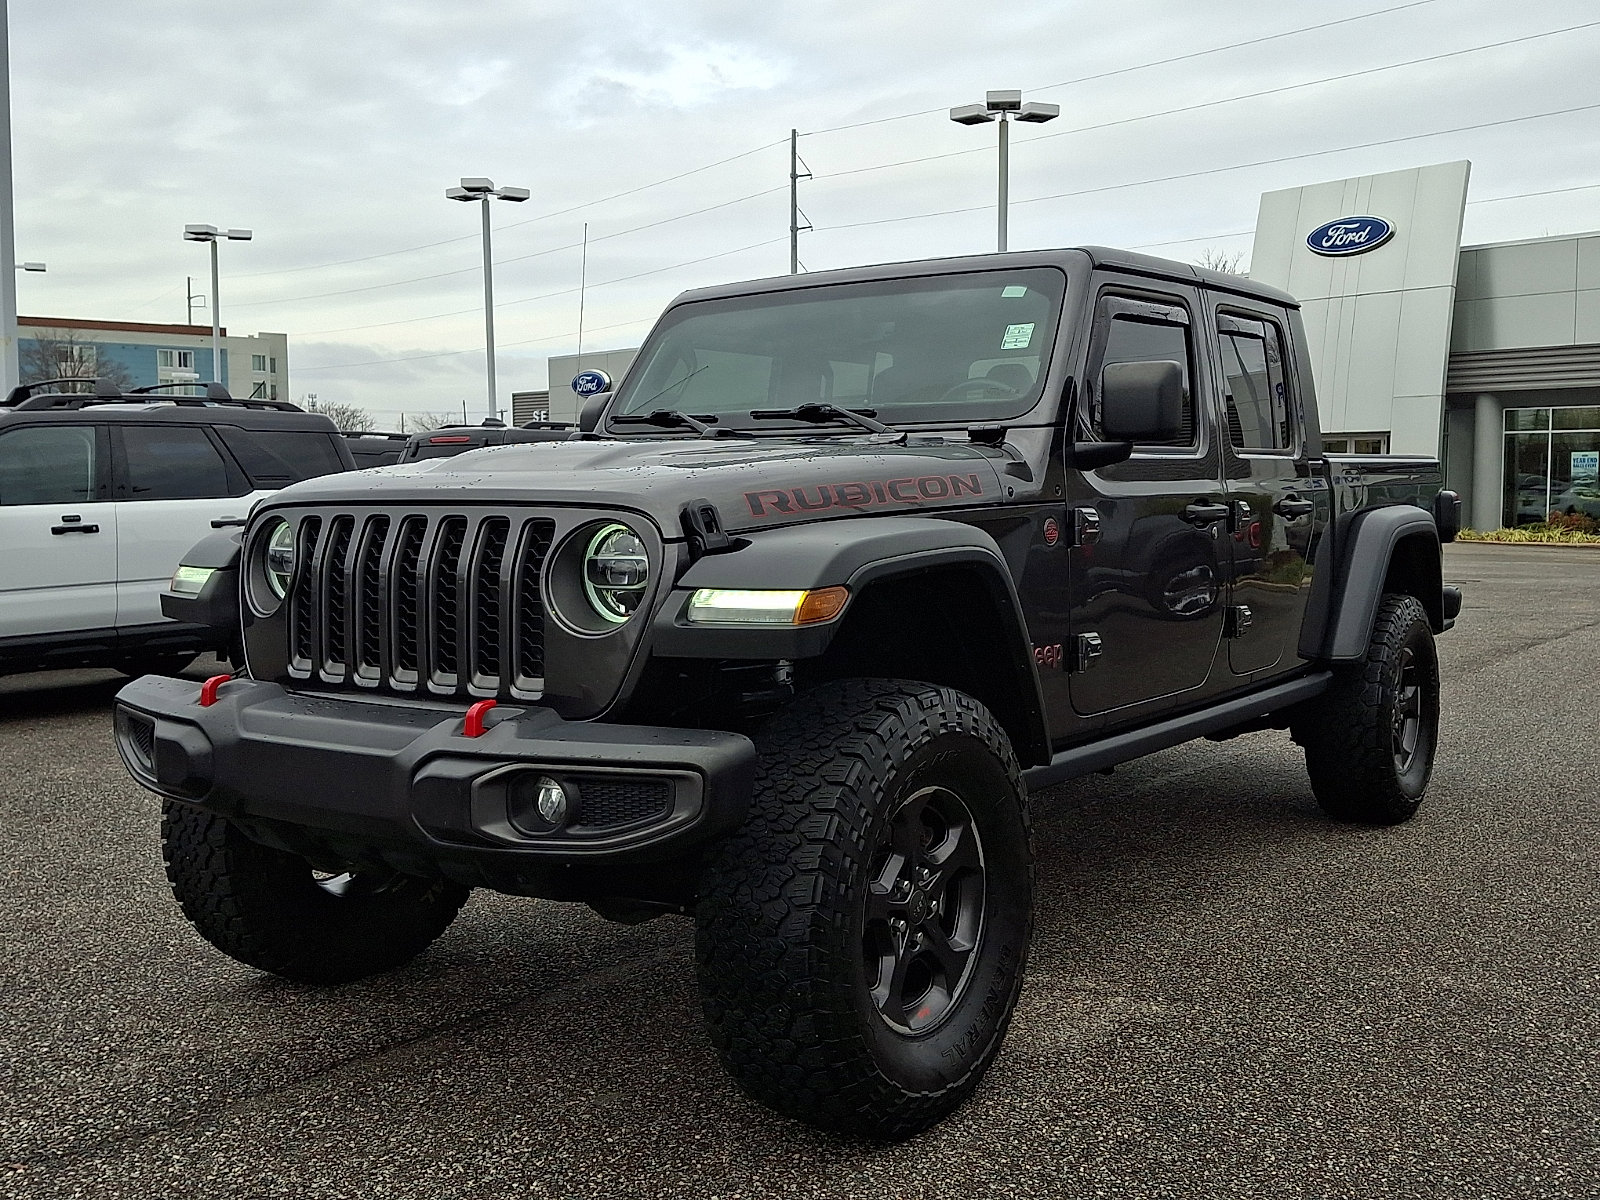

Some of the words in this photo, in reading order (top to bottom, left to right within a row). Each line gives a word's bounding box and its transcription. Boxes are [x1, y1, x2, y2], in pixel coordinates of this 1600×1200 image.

[1322, 223, 1372, 247] Ford
[577, 376, 598, 392] Ford
[743, 473, 983, 518] RUBICON
[1032, 643, 1063, 668] eep
[941, 944, 1011, 1067] GENERAL
